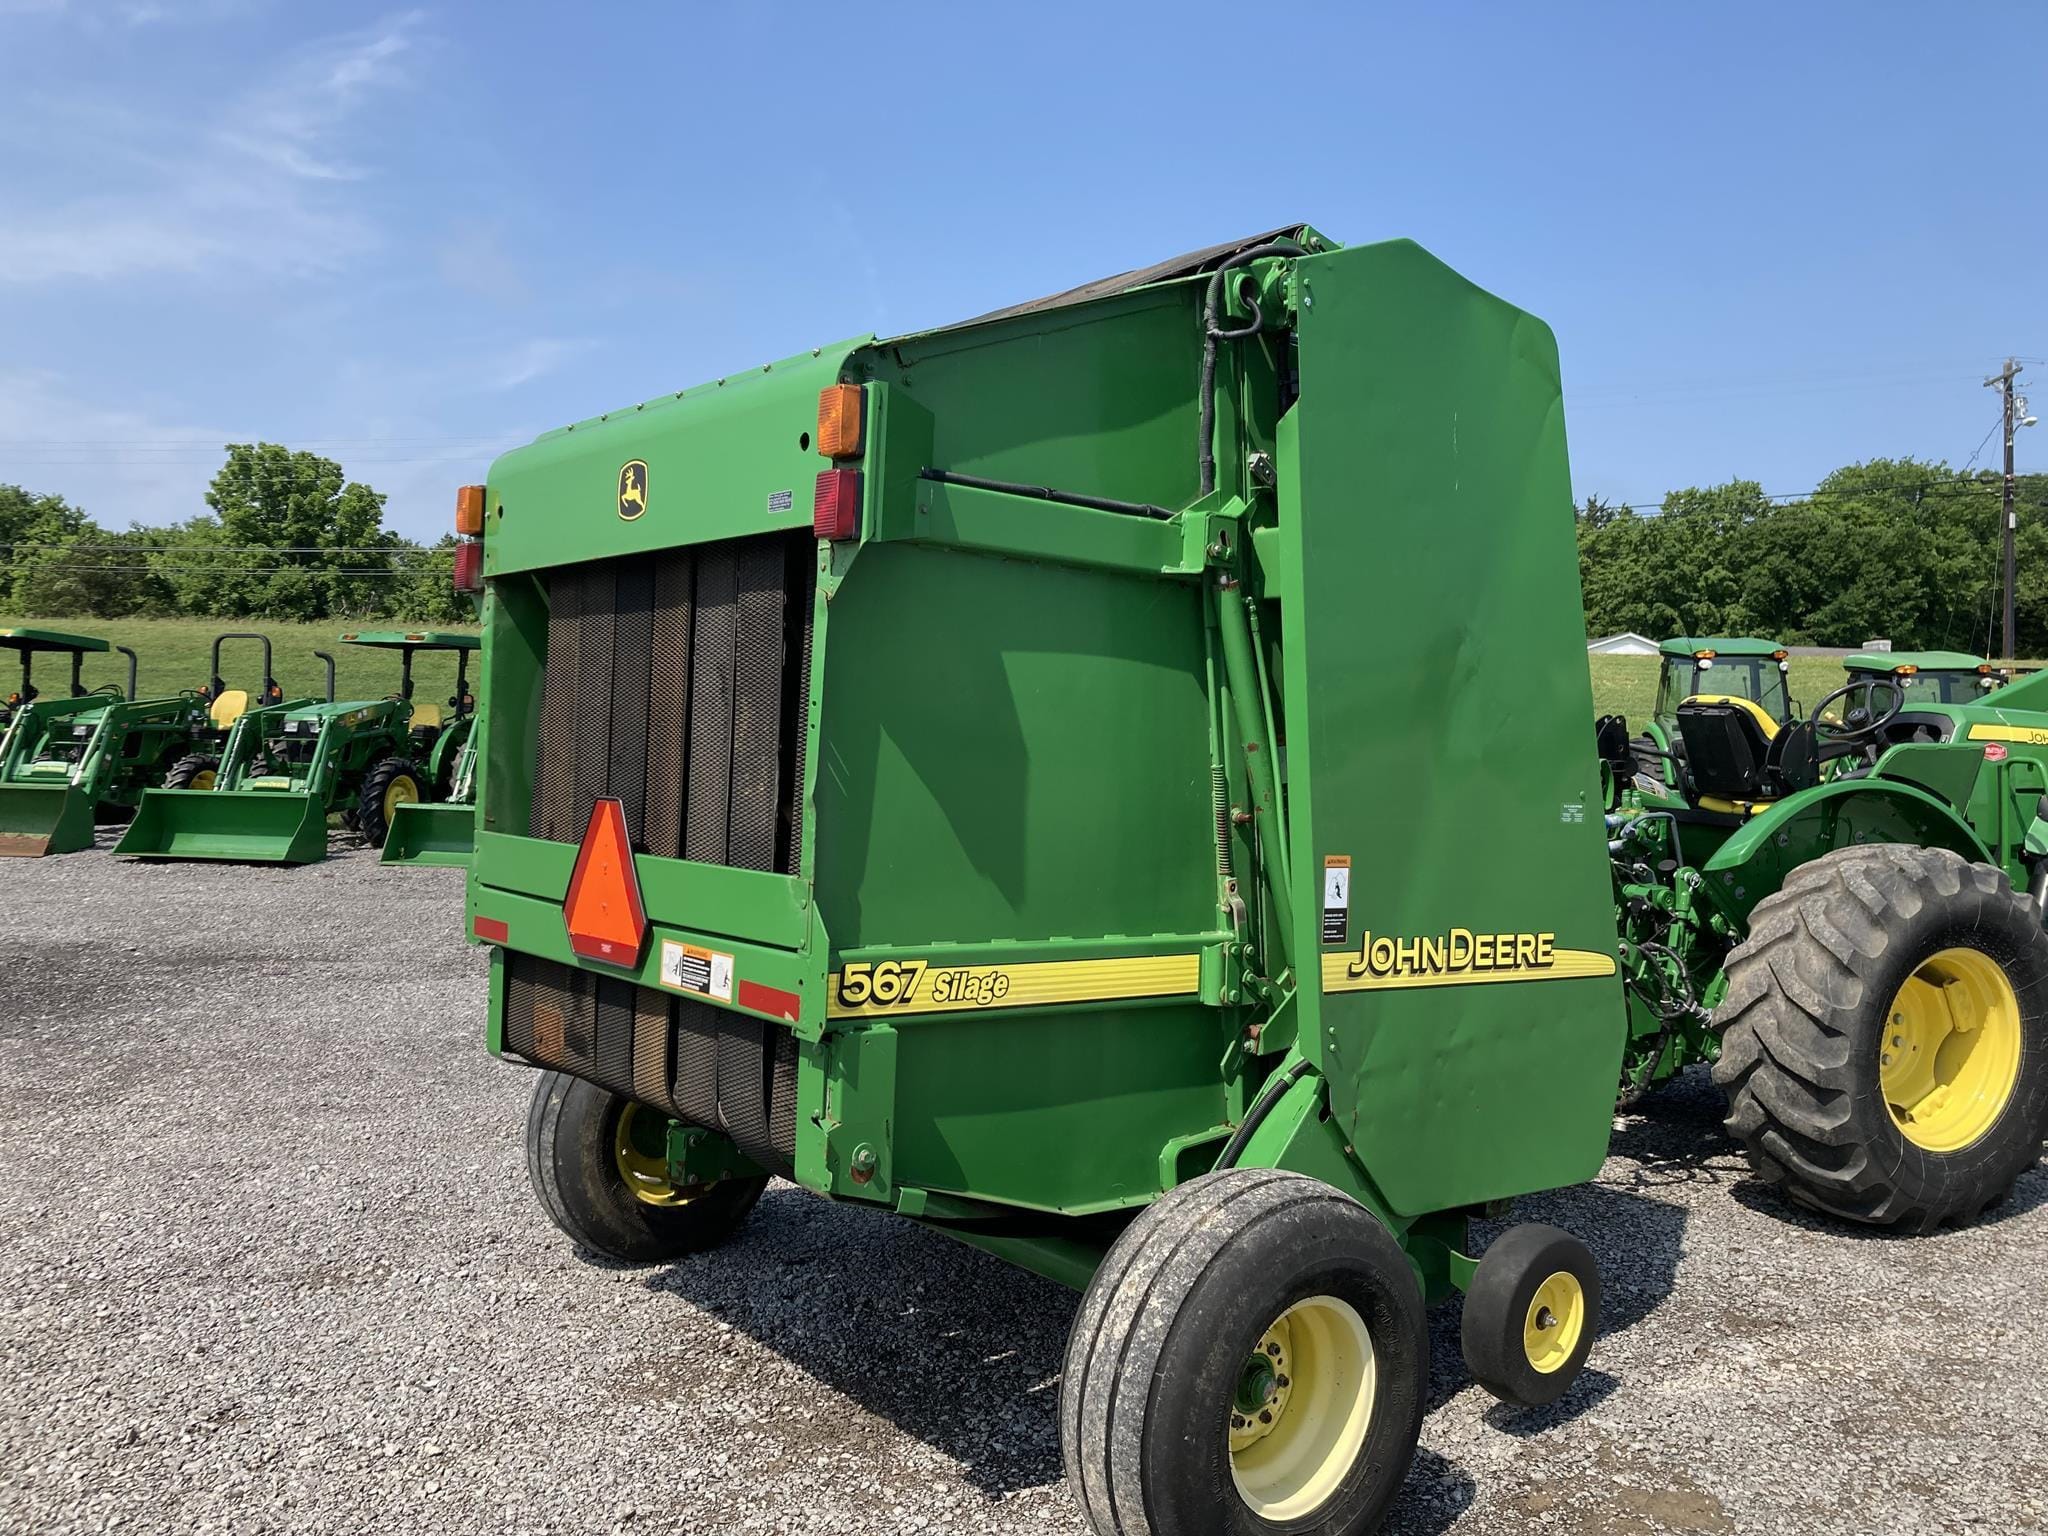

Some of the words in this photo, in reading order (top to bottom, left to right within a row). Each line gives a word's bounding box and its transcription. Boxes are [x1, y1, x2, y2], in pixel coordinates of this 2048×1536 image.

[1349, 930, 1444, 977] JOHN
[1447, 927, 1555, 971] DEERE
[839, 960, 928, 1007] 567
[932, 970, 1010, 1006] Silage
